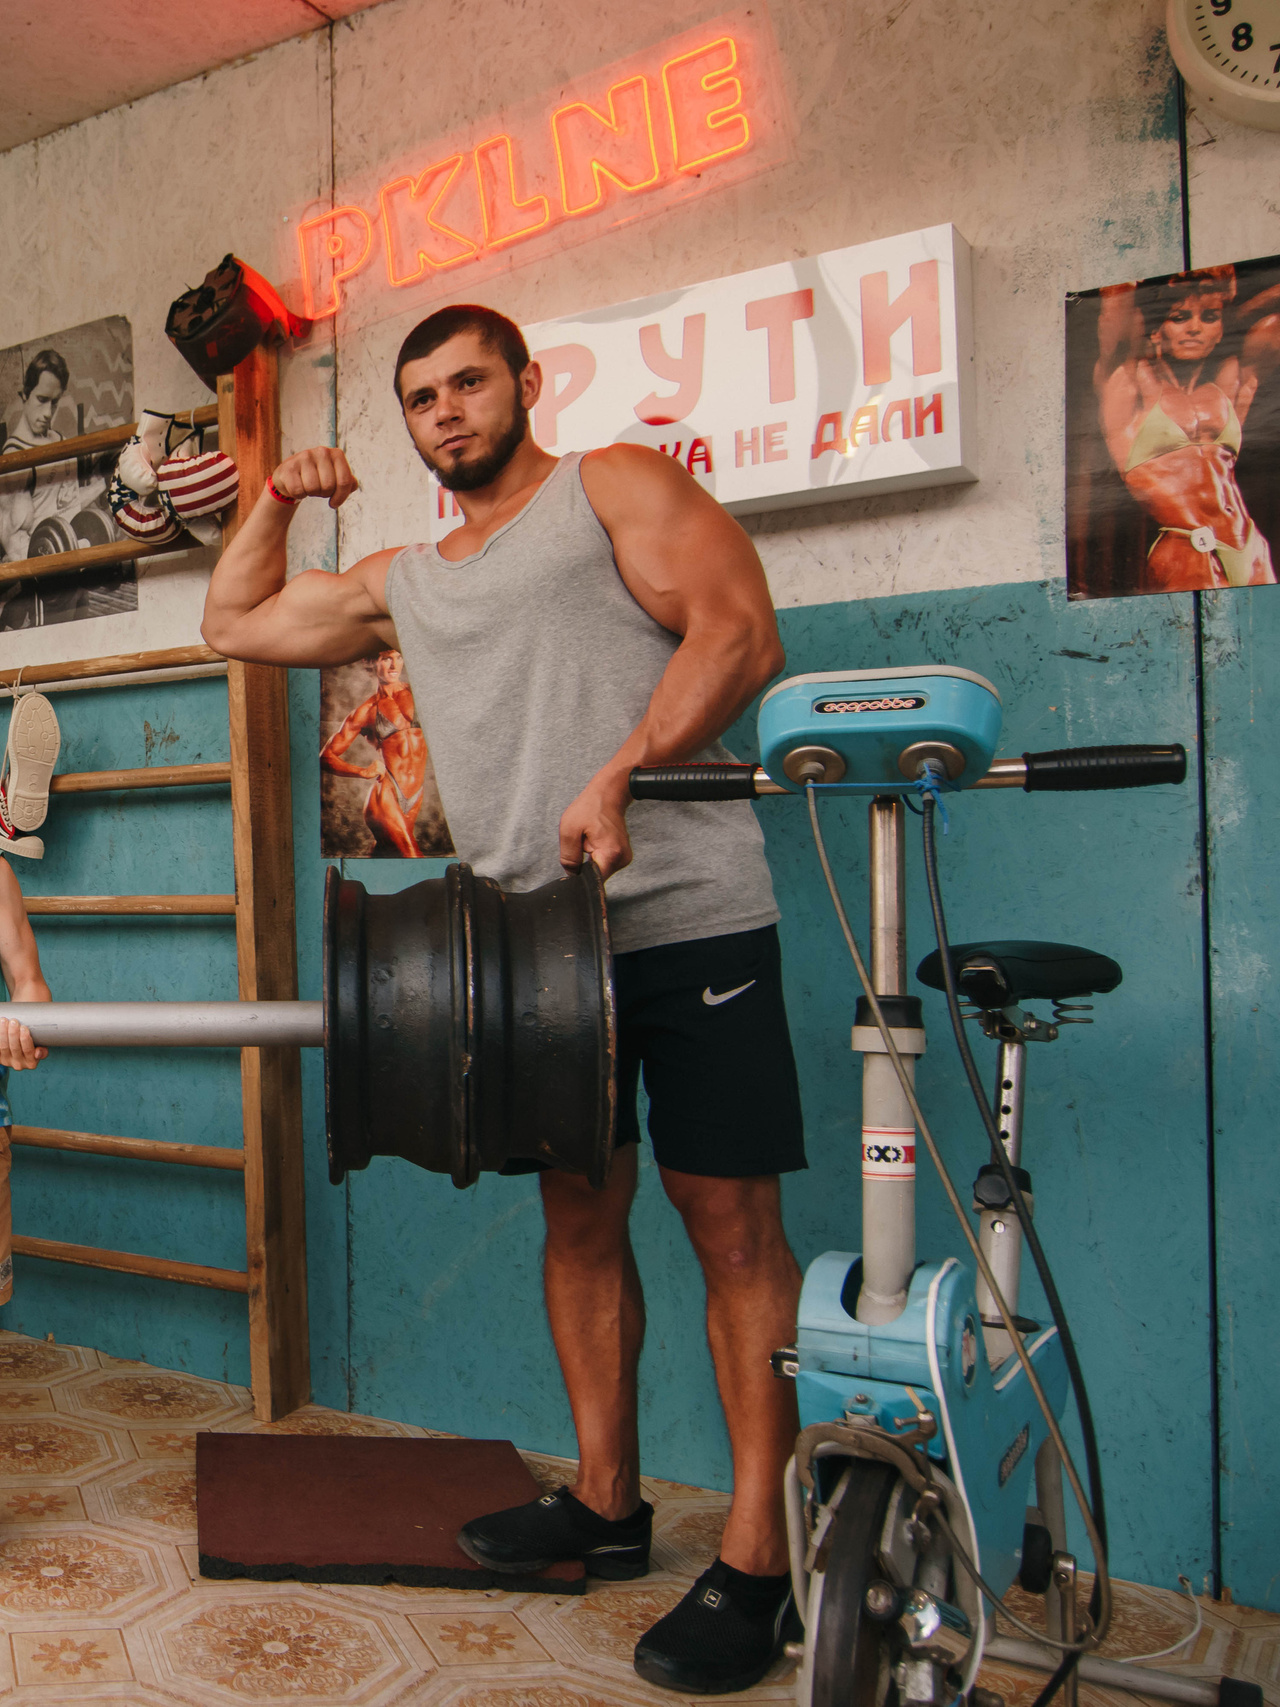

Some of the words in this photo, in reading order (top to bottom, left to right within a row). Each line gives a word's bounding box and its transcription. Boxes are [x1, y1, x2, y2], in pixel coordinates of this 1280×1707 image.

[1231, 22, 1254, 52] 8
[297, 36, 750, 320] PKLNE
[532, 259, 942, 447] РУТИ
[734, 421, 788, 468] НЕ
[811, 393, 943, 460] ДАЛИ
